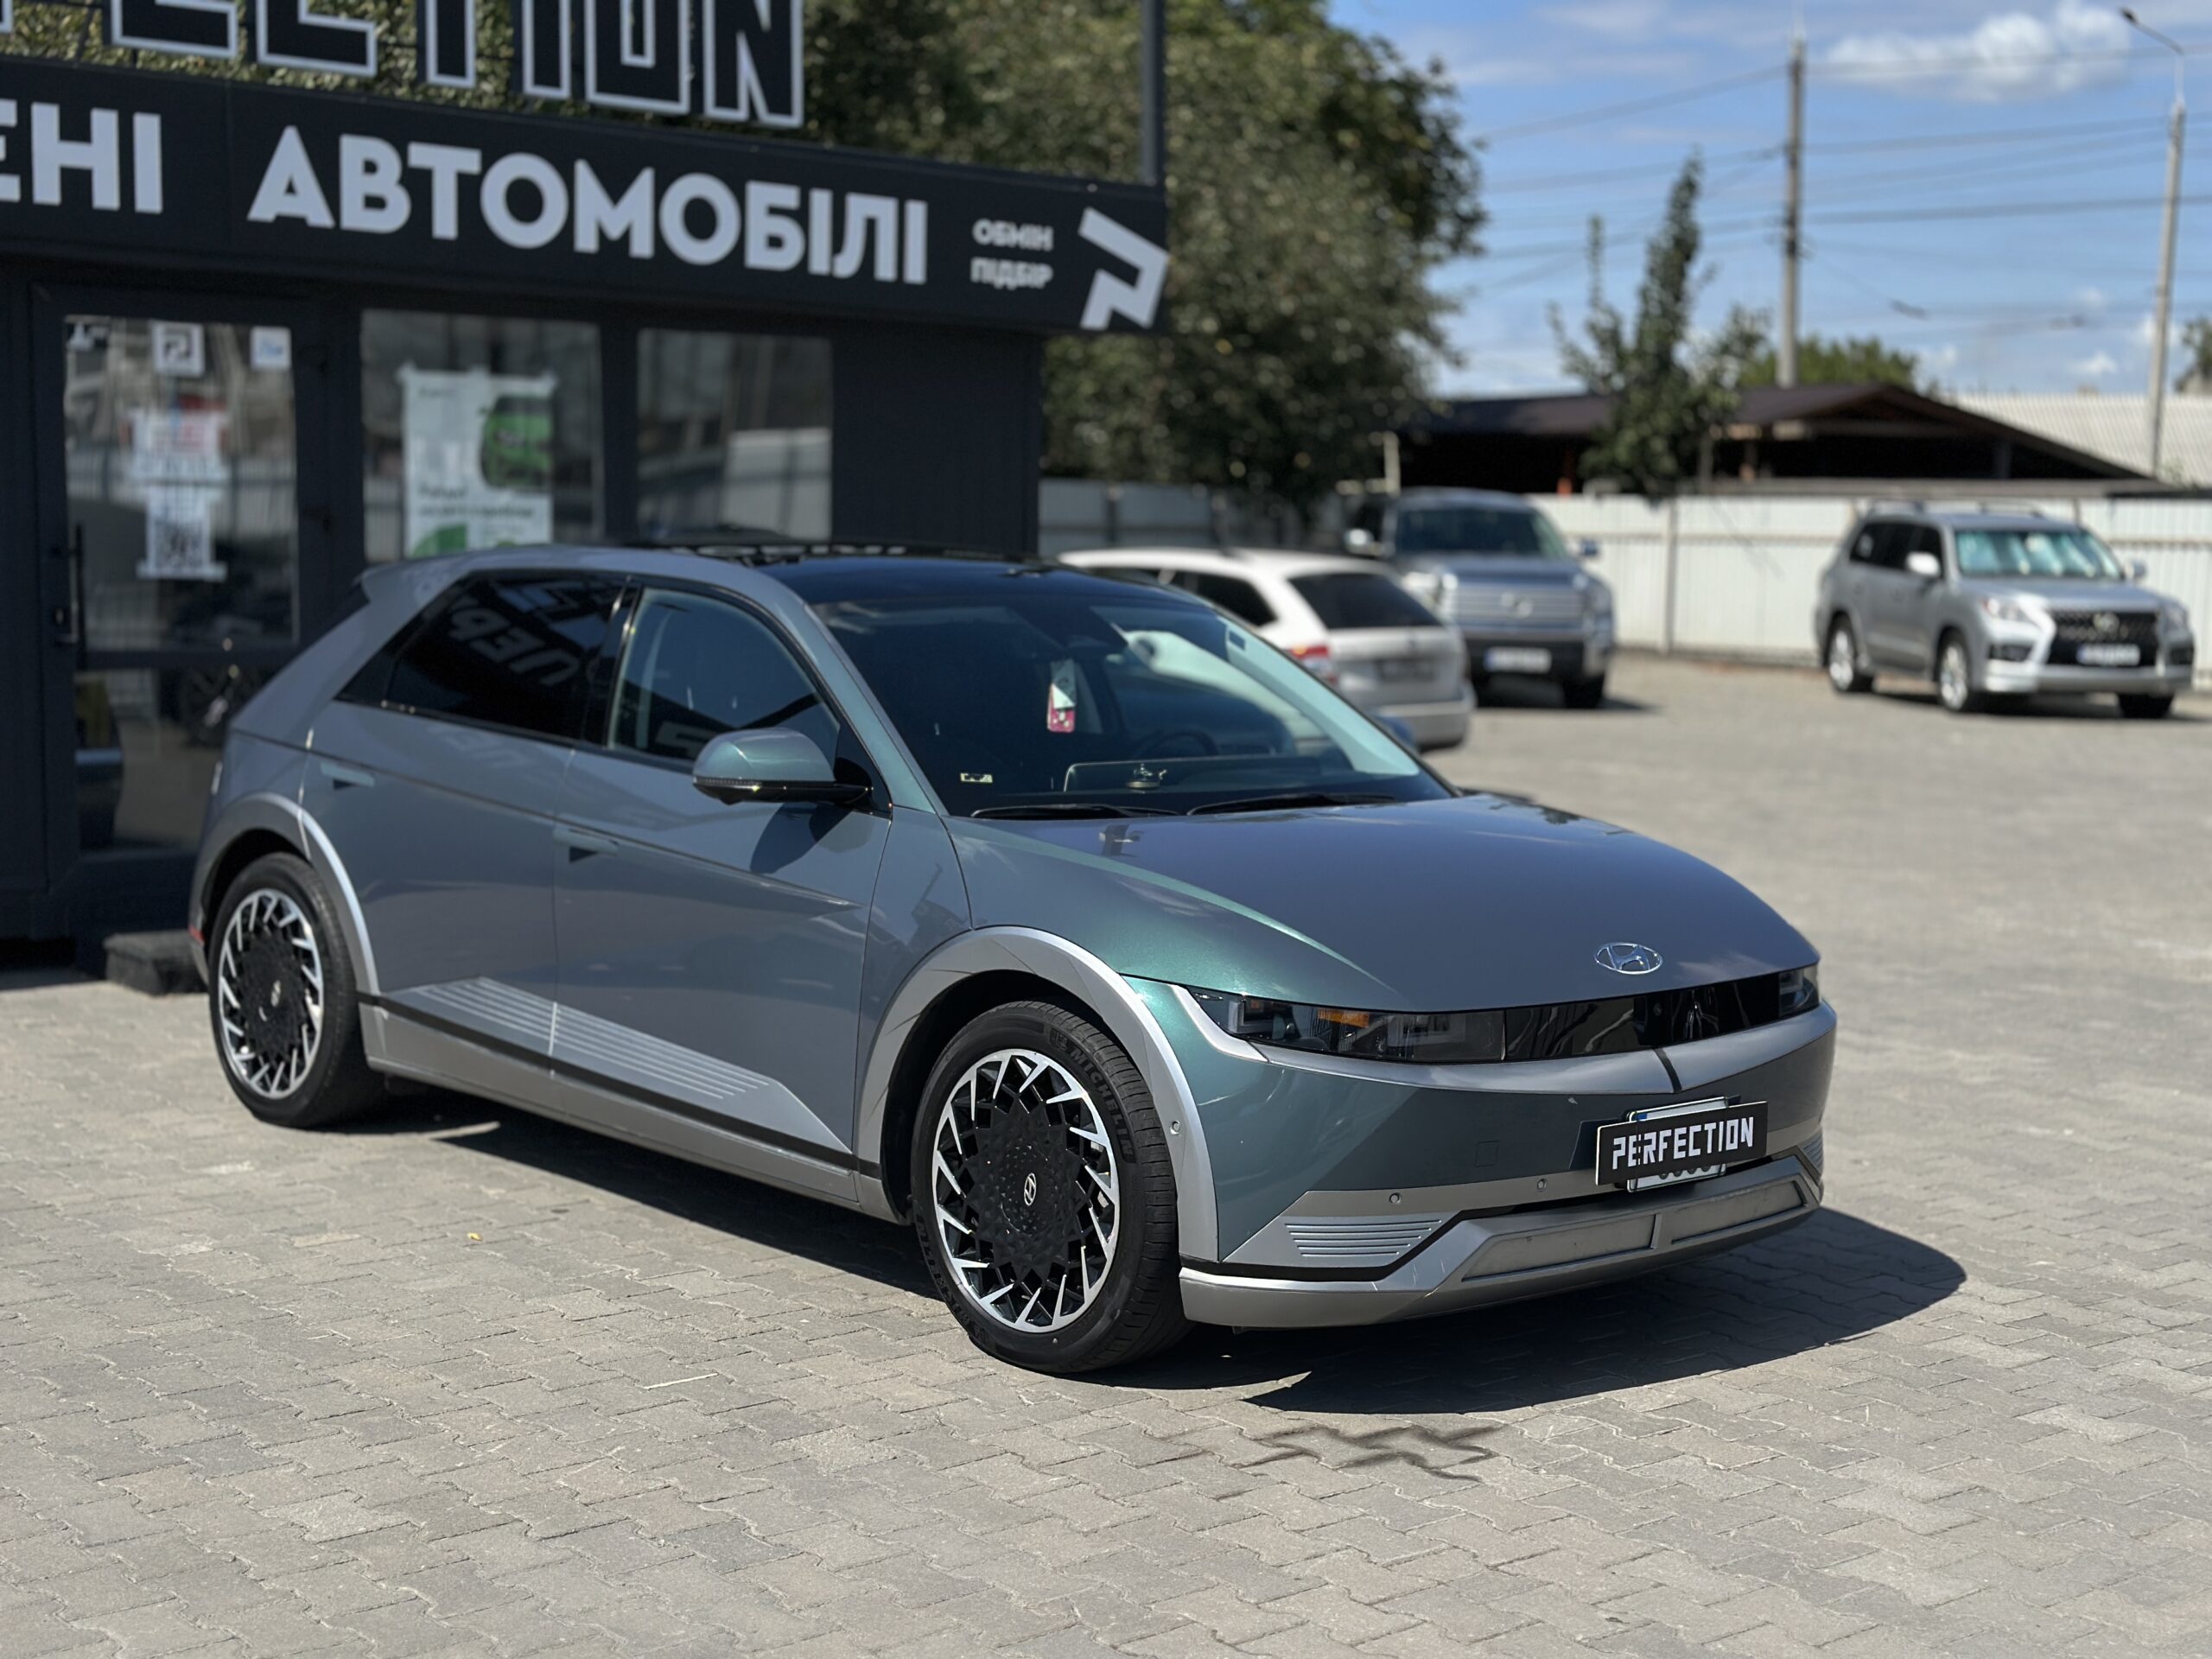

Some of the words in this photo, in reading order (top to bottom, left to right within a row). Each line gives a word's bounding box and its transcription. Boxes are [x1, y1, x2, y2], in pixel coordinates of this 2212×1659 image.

[111, 0, 804, 129] ION
[247, 125, 928, 284] АВТОМОБІЛІ
[1069, 1049, 1135, 1154] MICHELIN
[1612, 1116, 1754, 1170] PERFECTION
